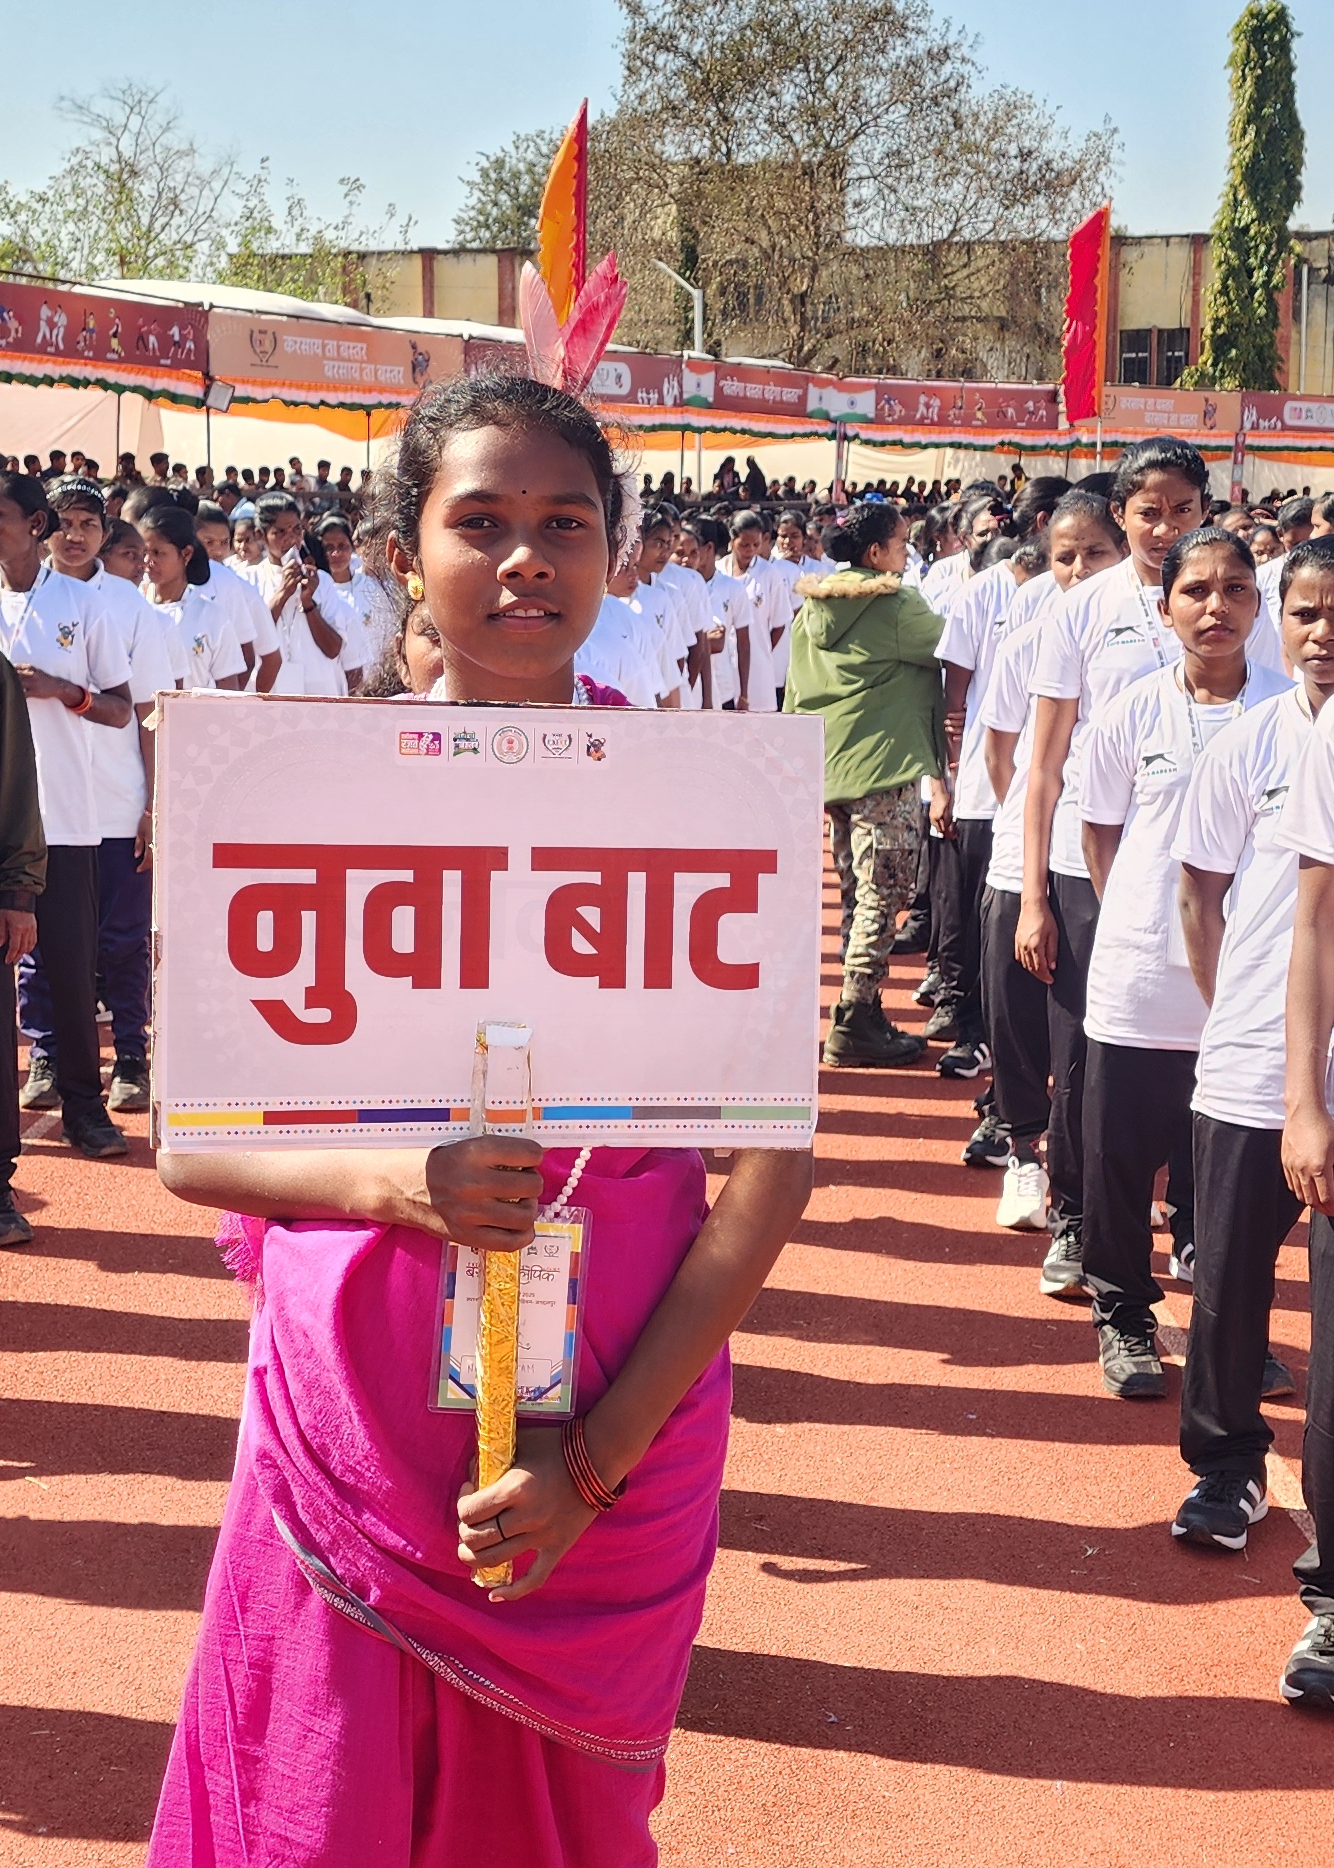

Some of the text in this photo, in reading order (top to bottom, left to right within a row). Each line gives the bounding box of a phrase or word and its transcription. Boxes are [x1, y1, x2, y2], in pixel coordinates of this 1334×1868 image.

[339, 340, 368, 361] बस्तर
[376, 364, 405, 385] बस्तर
[212, 843, 779, 1045] नुवा बाट
